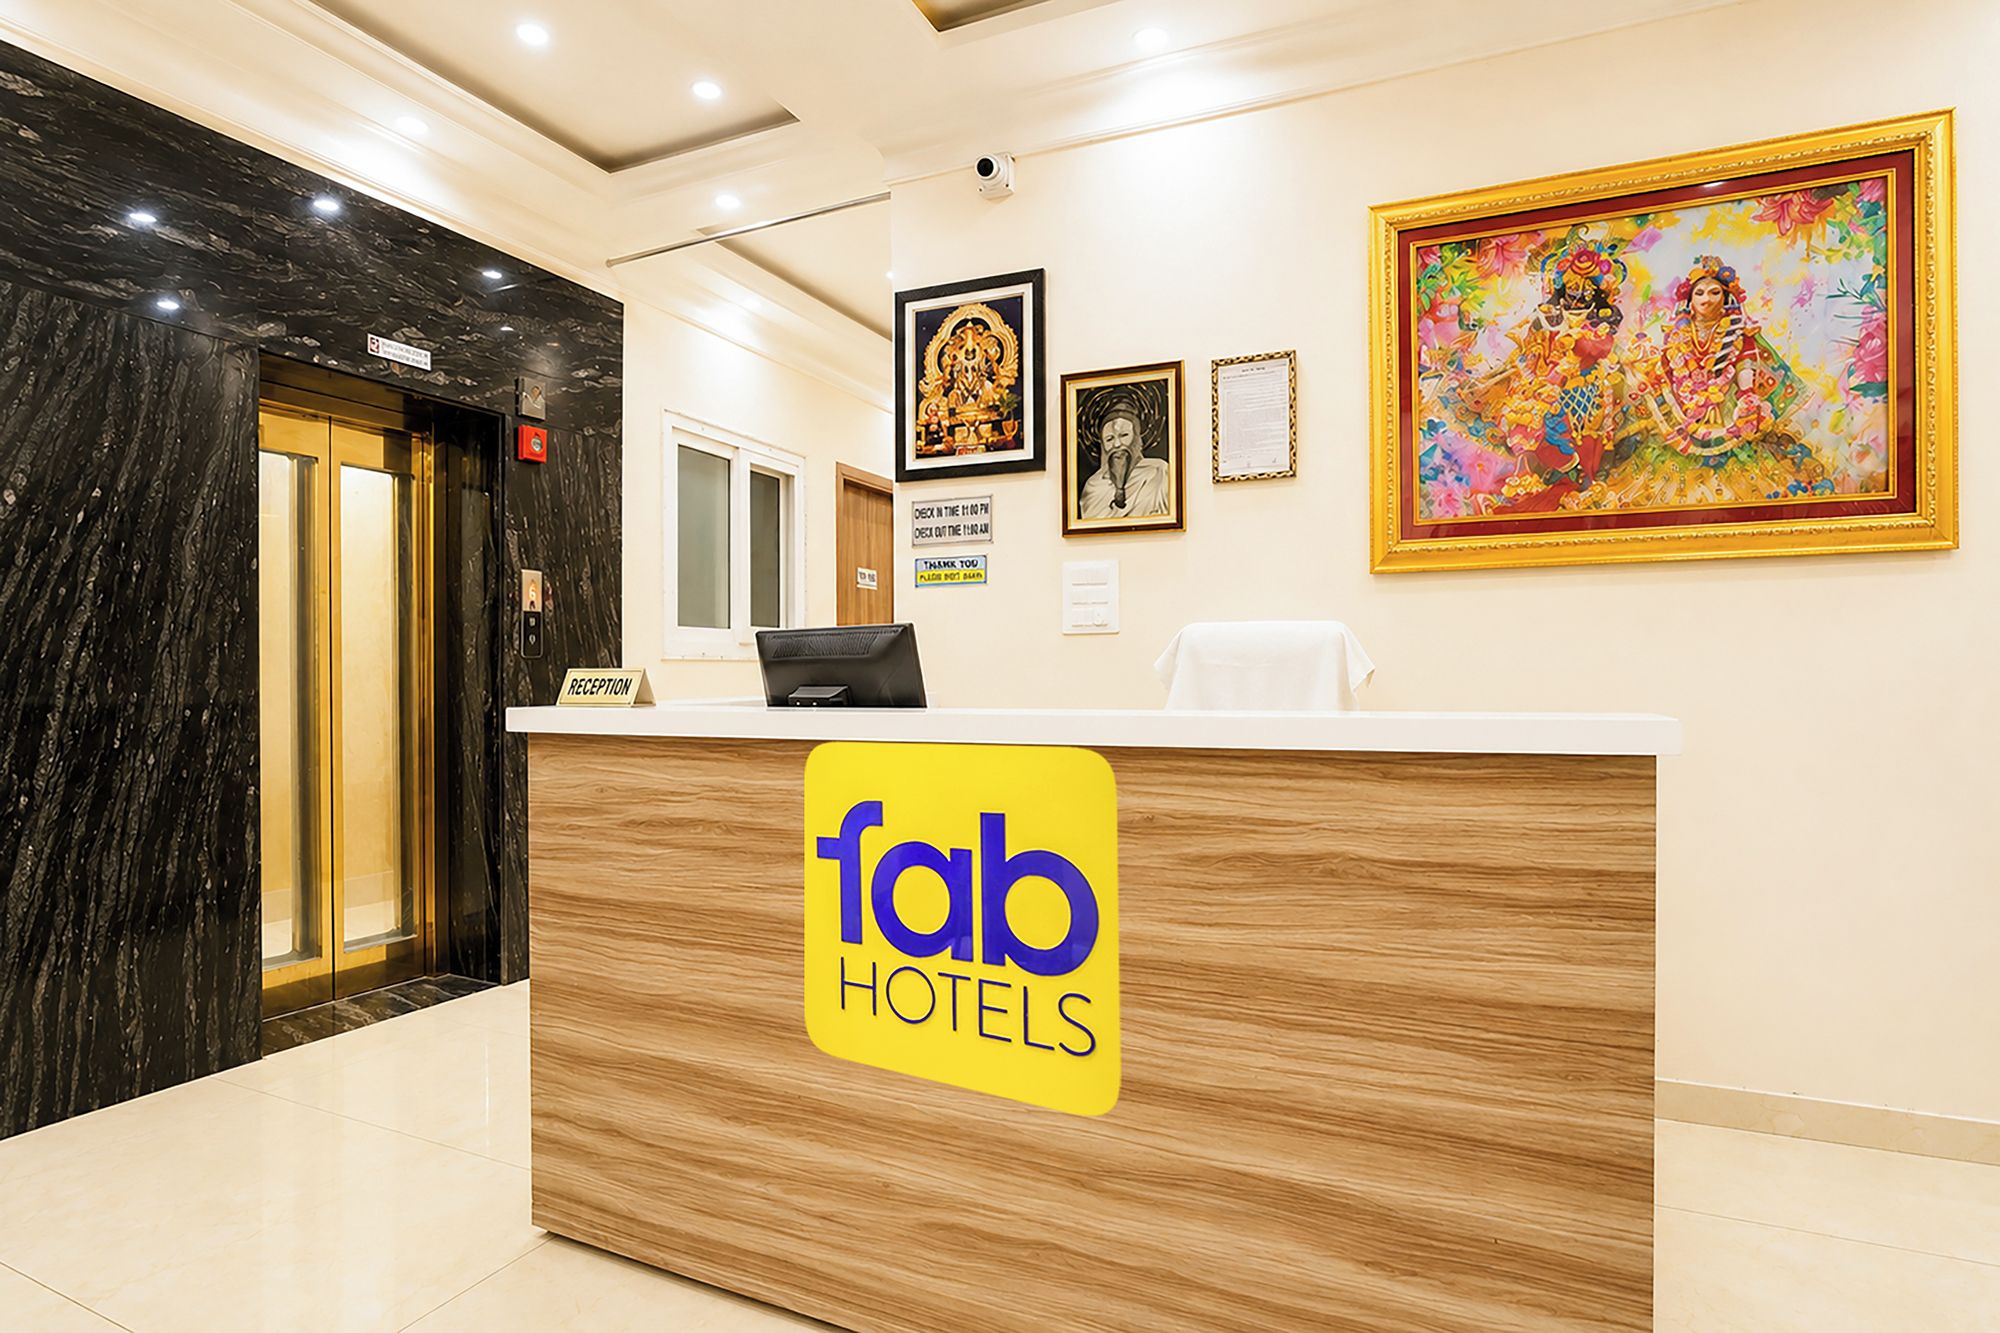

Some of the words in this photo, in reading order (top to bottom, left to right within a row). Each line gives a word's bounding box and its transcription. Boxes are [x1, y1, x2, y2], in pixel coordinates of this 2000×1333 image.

[567, 677, 633, 696] RECEPTION
[816, 800, 1099, 977] fab
[840, 956, 1097, 1058] HOTELS
